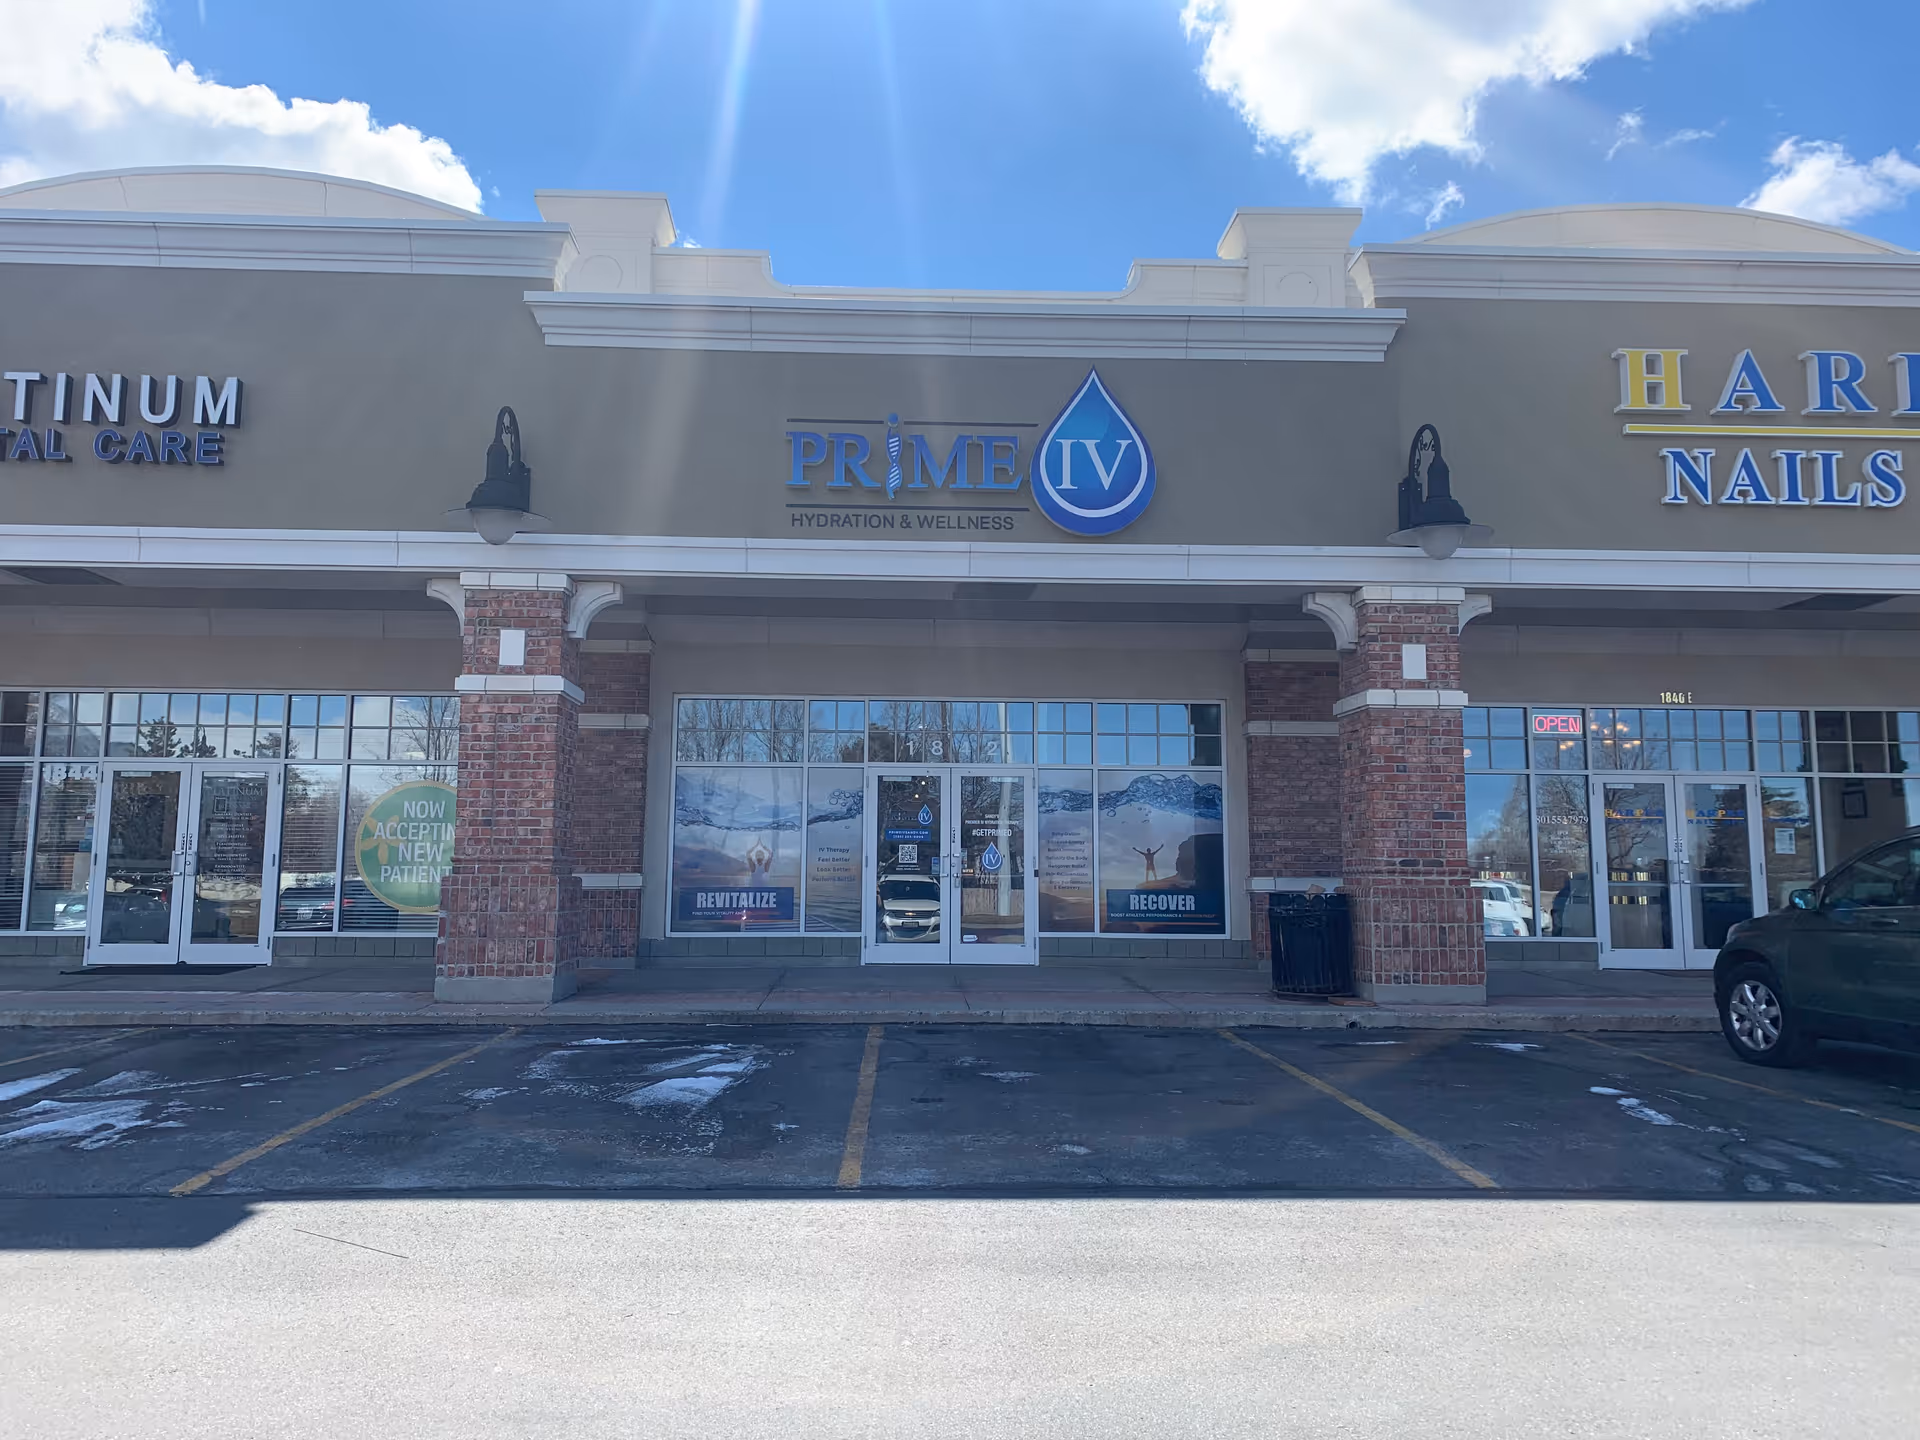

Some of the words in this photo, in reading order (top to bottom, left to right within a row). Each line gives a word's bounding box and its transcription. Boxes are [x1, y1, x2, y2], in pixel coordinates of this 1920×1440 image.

[3, 371, 242, 427] TINUM
[93, 428, 225, 466] CARE
[1055, 438, 1133, 491] IV
[1659, 448, 1907, 508] NAILS
[791, 513, 895, 530] HYDRATION
[900, 515, 913, 530] &
[916, 515, 1015, 531] WELLNESS
[1535, 716, 1580, 732] OPEN
[42, 763, 98, 781] 1844
[403, 800, 446, 818] NOW
[920, 813, 930, 821] IV
[398, 842, 444, 862] NEW
[985, 853, 999, 865] IV
[696, 892, 777, 909] REVITALIZE
[1129, 894, 1196, 911] RECOVER
